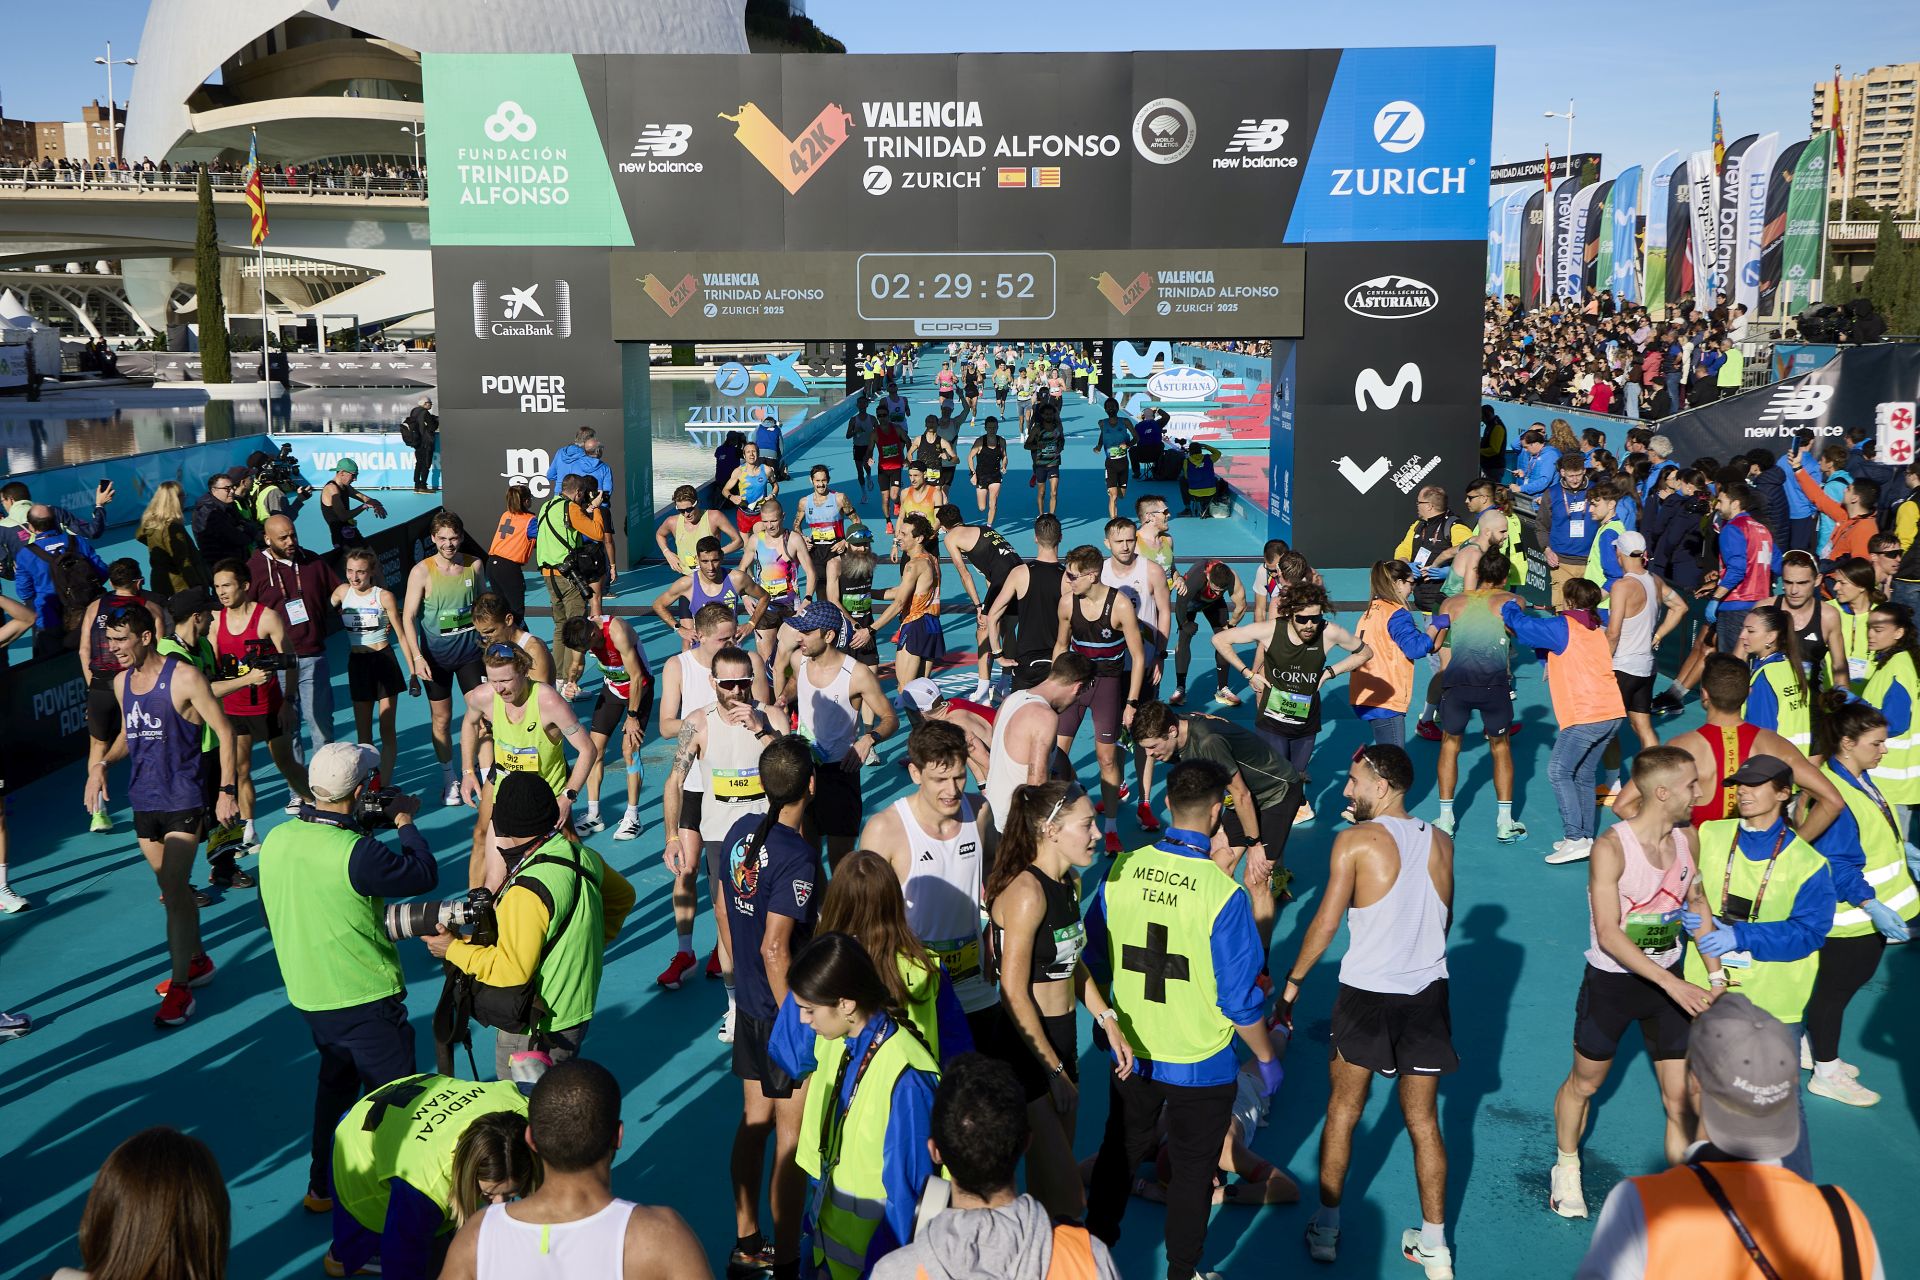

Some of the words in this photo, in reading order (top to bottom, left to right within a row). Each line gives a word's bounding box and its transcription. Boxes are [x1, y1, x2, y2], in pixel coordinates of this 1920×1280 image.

[862, 102, 983, 127] VALENCIA
[458, 146, 567, 161] FUNDACIÓN
[789, 120, 836, 178] 42K
[864, 136, 987, 158] TRINIDAD
[993, 135, 1120, 157] ALFONSO
[619, 162, 646, 174] new
[647, 160, 704, 174] balance
[1212, 157, 1240, 169] new
[1242, 156, 1298, 169] balance
[457, 165, 569, 185] TRINIDAD
[902, 170, 981, 189] ZURICH
[1330, 167, 1466, 196] ZURICH
[1490, 166, 1516, 179] RINIDAD
[1723, 156, 1742, 203] new
[459, 187, 569, 205] ALFONSO
[1558, 193, 1572, 229] new
[1571, 208, 1588, 267] ZURICH
[703, 273, 760, 286] VALENCIA
[870, 273, 1035, 300] 02:29:52
[1157, 271, 1214, 284] VALENCIA
[704, 289, 763, 300] TRINIDAD
[765, 289, 824, 300] ALFONSO
[1158, 287, 1216, 298] TRINIDAD
[1219, 286, 1279, 298] ALFONSO
[1352, 291, 1431, 308] ASTURIANA
[722, 306, 759, 315] ZURICH
[764, 306, 785, 315] 2025
[1175, 303, 1214, 313] ZURICH
[1217, 303, 1239, 312] 2025
[491, 323, 554, 337] CaixaBank
[921, 323, 993, 332] COROS
[482, 376, 565, 394] POWER
[1155, 380, 1211, 391] ASTURIANA
[521, 395, 566, 412] ADE
[688, 405, 779, 423] ZURICH
[1744, 427, 1776, 437] new
[1390, 454, 1422, 482] VALENCIA
[1396, 464, 1422, 489] CIUDAD
[1401, 477, 1417, 495] DEL
[1414, 455, 1442, 483] RUNNING
[1272, 668, 1317, 684] CORNR
[33, 676, 87, 720] POWER
[1281, 699, 1297, 708] 2450
[729, 779, 749, 787] 1462
[1132, 866, 1198, 892] MEDICAL
[1142, 887, 1178, 908] TEAM
[411, 1090, 459, 1120] TEAM
[416, 1087, 486, 1141] MEDICAL
